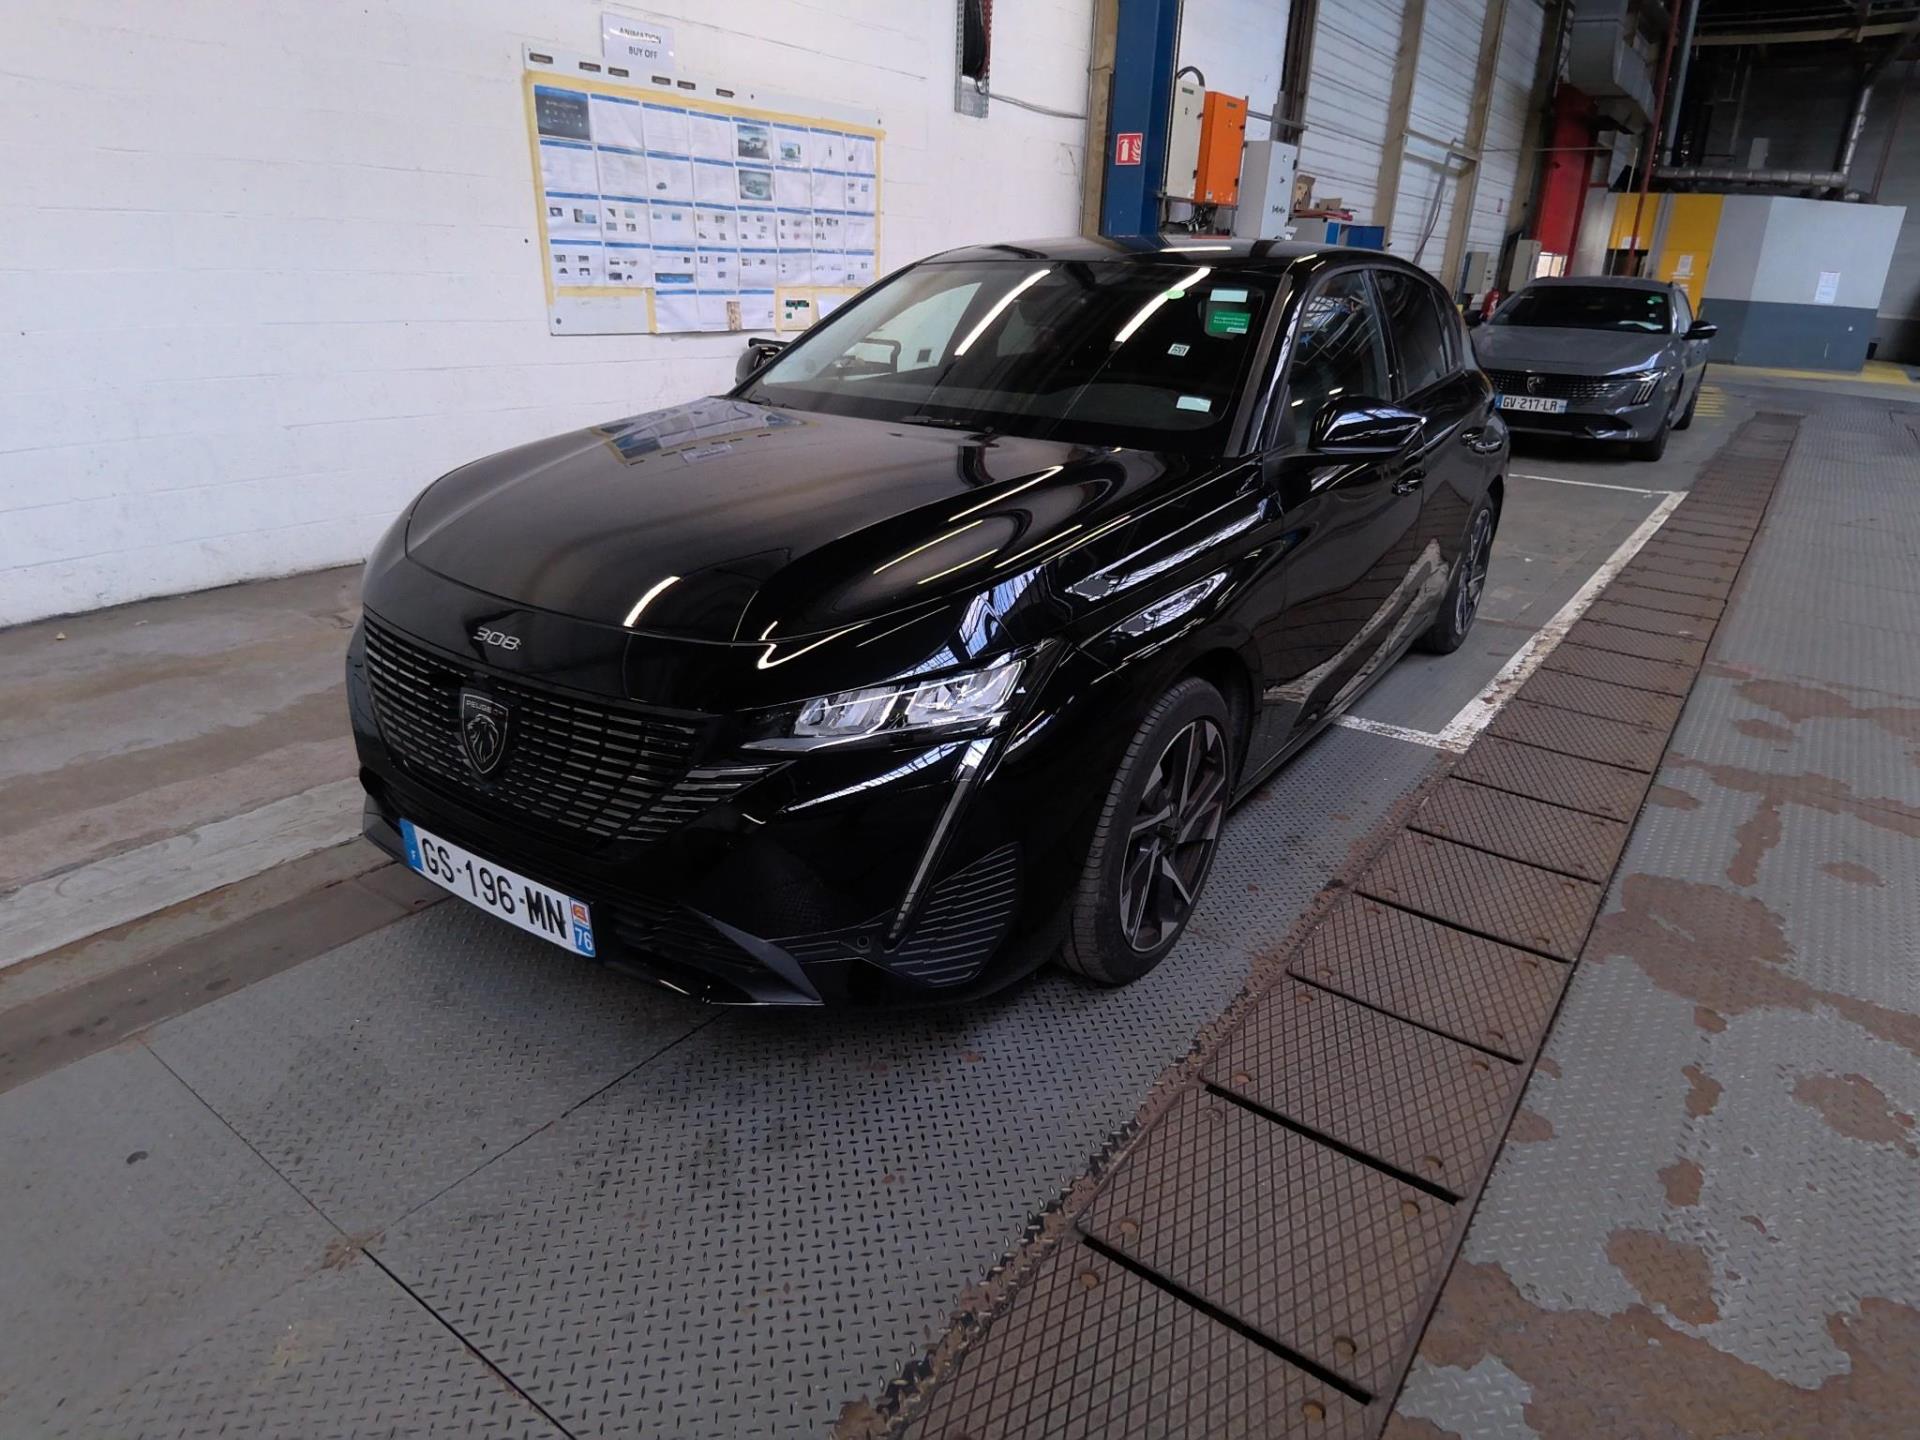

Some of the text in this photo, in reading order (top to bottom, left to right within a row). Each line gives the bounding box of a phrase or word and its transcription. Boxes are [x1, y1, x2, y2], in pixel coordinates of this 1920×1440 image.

[628, 46, 657, 59] BUY OFF
[473, 627, 520, 650] 308
[421, 838, 568, 940] GS-196-MN
[575, 927, 593, 951] 76
